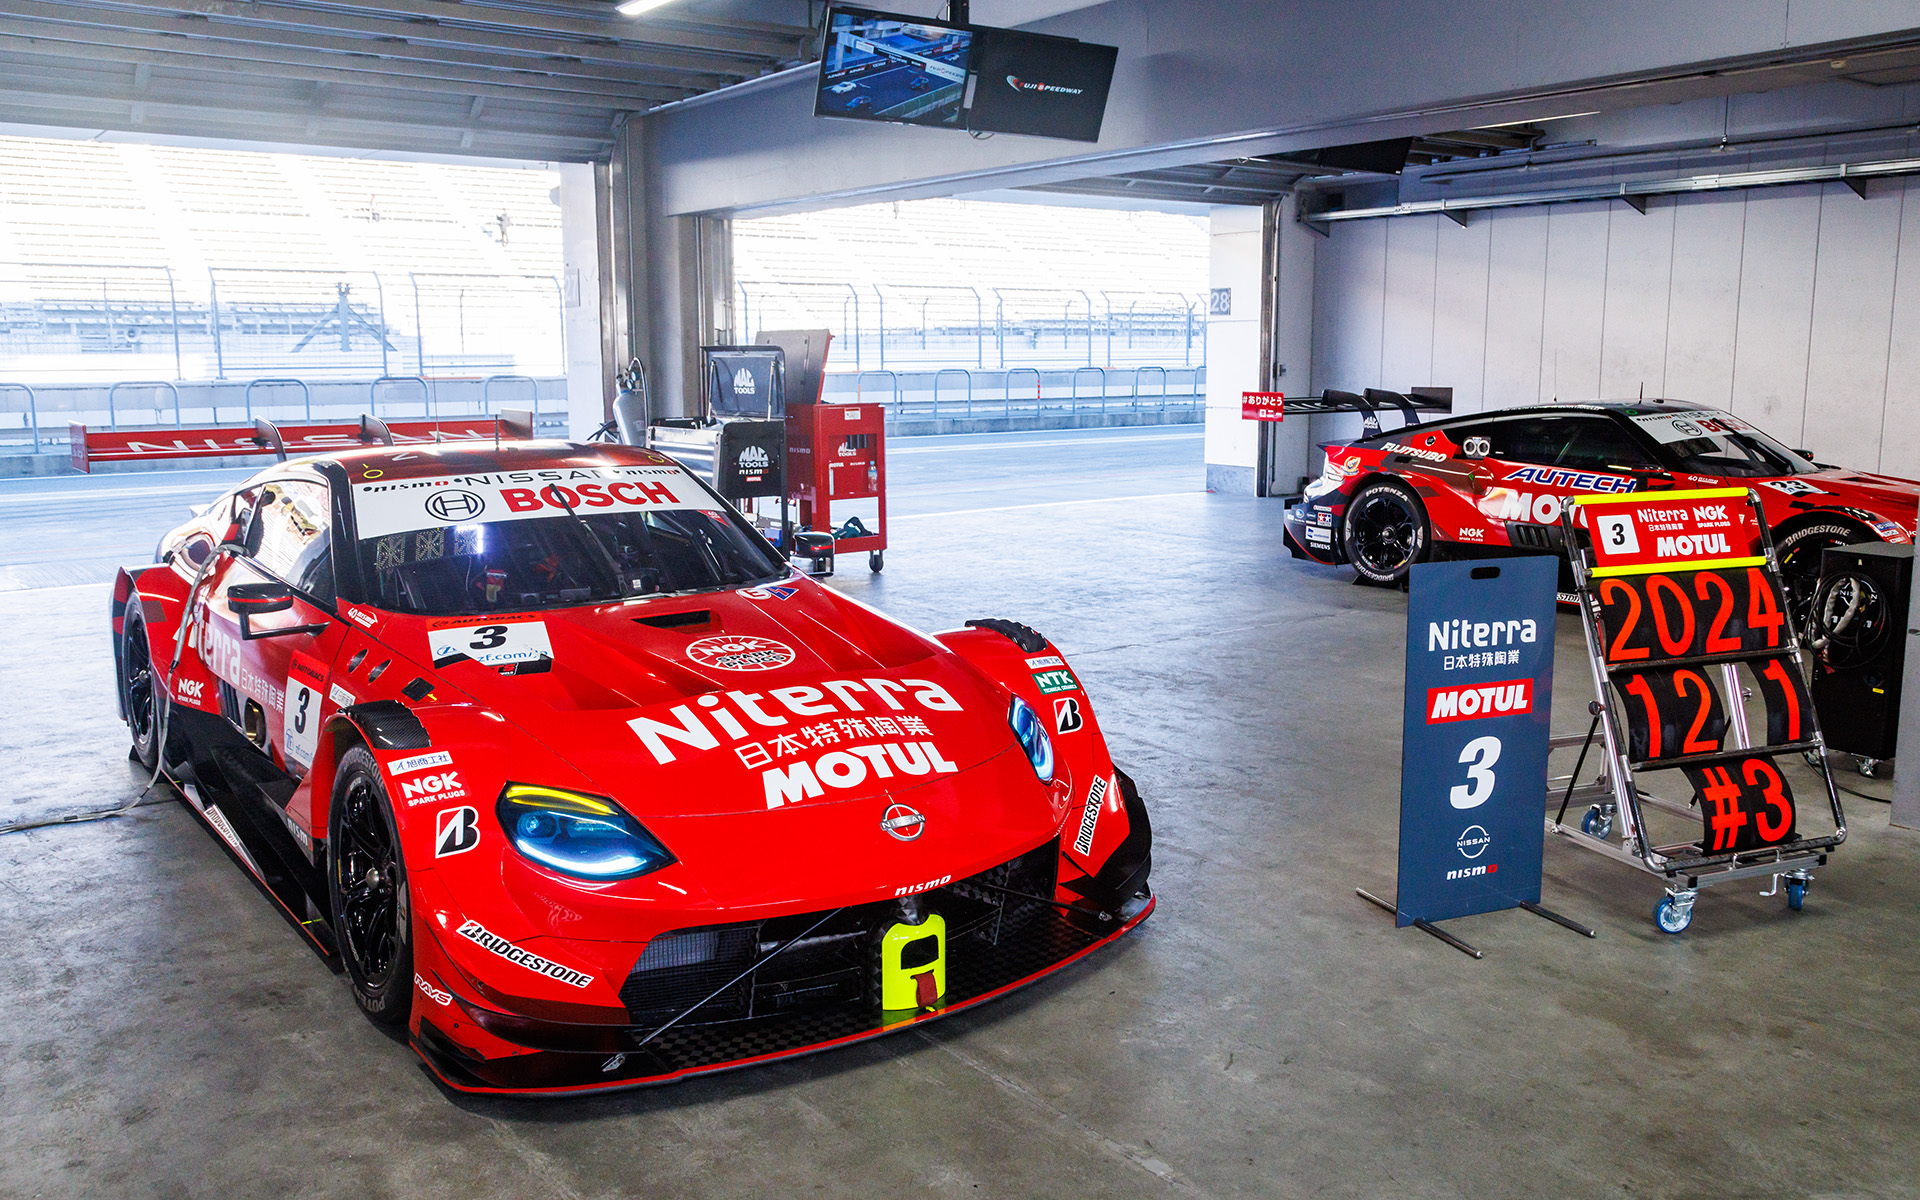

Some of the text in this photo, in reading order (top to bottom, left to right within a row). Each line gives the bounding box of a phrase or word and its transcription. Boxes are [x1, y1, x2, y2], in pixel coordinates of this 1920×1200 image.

[1211, 291, 1229, 312] 28
[734, 368, 754, 386] MAC
[1260, 409, 1282, 417] ロニー
[739, 446, 769, 461] MAC
[1380, 442, 1447, 462] FUJITSUBO
[374, 481, 449, 493] nismo
[1502, 467, 1636, 493] AUTECH
[499, 481, 681, 512] BOSCH
[1366, 487, 1408, 501] POTENZA
[1637, 505, 1729, 523] Niterra NGK
[1459, 528, 1484, 537] NGK
[1612, 523, 1624, 546] 3
[1785, 524, 1851, 546] BRIDGESTONE
[1657, 533, 1731, 557] MOTUL
[348, 608, 358, 618] 40
[1600, 567, 1784, 661] 2024
[469, 626, 508, 649] 3
[1428, 619, 1537, 651] Niterra
[698, 640, 766, 656] NGK
[716, 650, 774, 662] SPARK
[725, 655, 787, 667] PLUGS
[1443, 649, 1520, 670] 日本特殊陶業
[297, 664, 324, 682] AUTOBACS
[1035, 671, 1073, 687] NTK
[178, 678, 204, 698] NGK
[1431, 683, 1528, 719] MOTUL
[1763, 659, 1800, 740] 1
[295, 687, 310, 734] 3
[626, 678, 964, 765] Niterra
[734, 715, 935, 769] 日本特殊陶業
[762, 741, 958, 809] MOTUL
[1450, 736, 1502, 809] 3
[401, 771, 462, 799] NGK
[408, 789, 465, 807] SPARK PLUGS
[1702, 758, 1793, 850] #3
[881, 814, 925, 829] NISSAN
[1075, 777, 1107, 856] BRIDGESTONE
[1456, 835, 1491, 847] NISSAN
[1446, 864, 1498, 880] nismo
[895, 874, 951, 896] nismo
[458, 921, 593, 988] BRIDGESTONE
[414, 973, 452, 1005] RAYS
